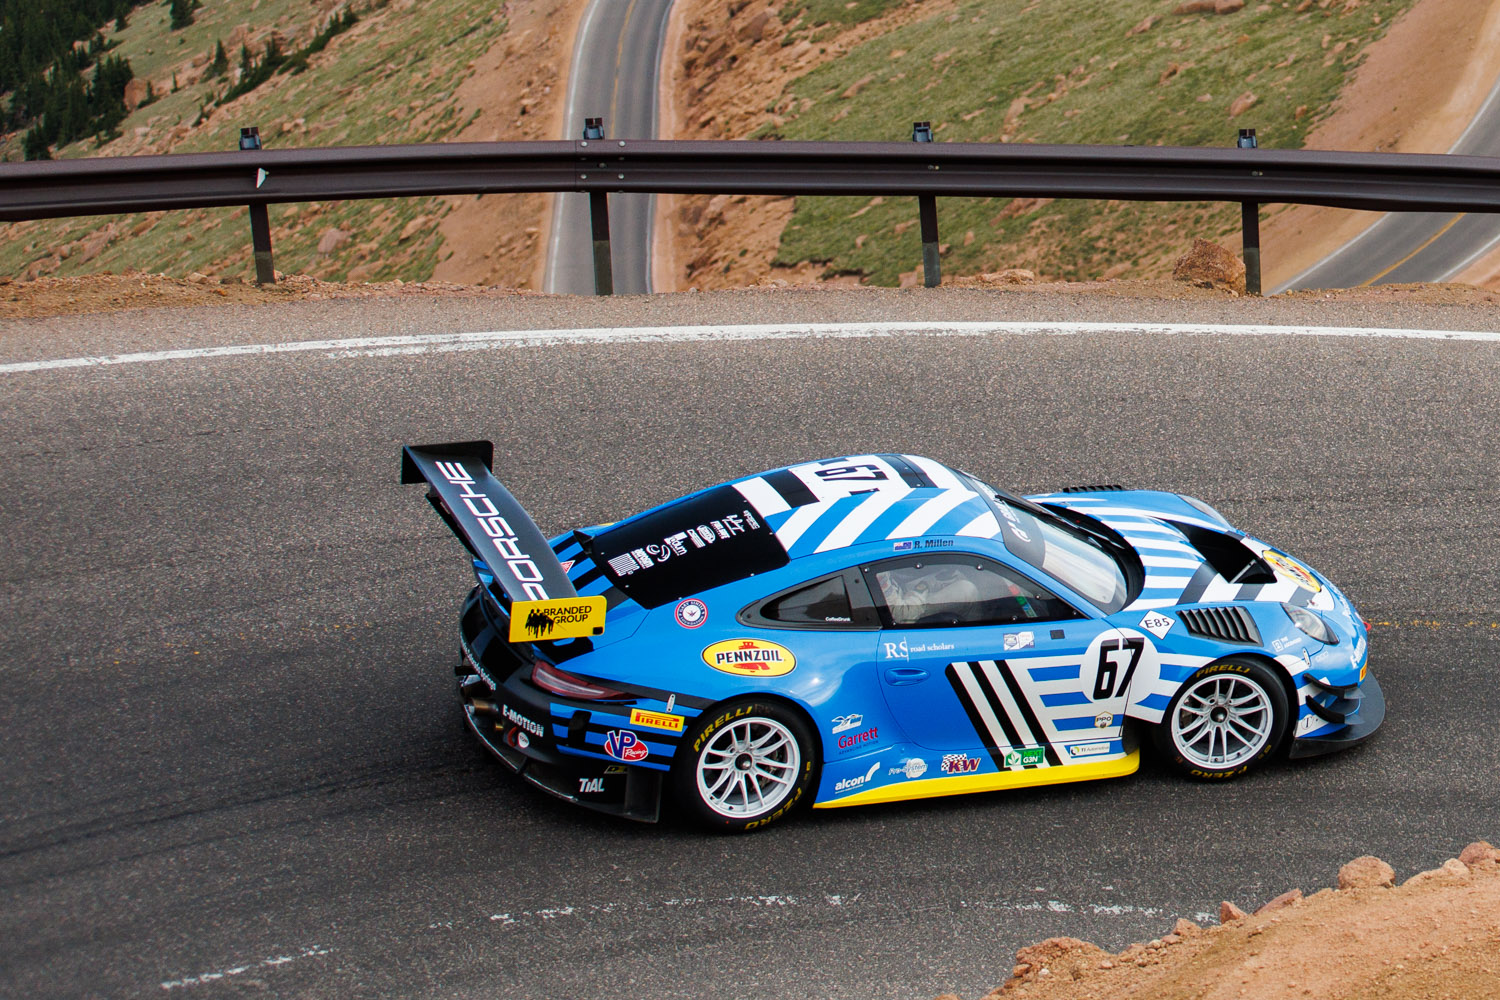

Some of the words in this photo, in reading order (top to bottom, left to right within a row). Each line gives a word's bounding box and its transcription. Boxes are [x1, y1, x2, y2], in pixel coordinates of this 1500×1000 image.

[814, 464, 889, 482] 67
[914, 539, 923, 549] R.
[924, 538, 954, 548] Millen
[542, 605, 592, 617] BRANDED
[552, 614, 589, 625] GROUP
[1144, 617, 1170, 629] E85
[716, 649, 783, 664] PENNZOIL
[885, 638, 909, 660] RS
[910, 643, 926, 653] road
[926, 642, 955, 652] scholars
[1093, 637, 1145, 701] 67
[1195, 664, 1251, 678] PIRELLI
[502, 704, 544, 737] E-MOTION
[635, 712, 680, 729] PIRELLI
[693, 705, 753, 752] PIRELLI
[607, 730, 637, 760] VP
[625, 748, 648, 757] Racing
[838, 727, 879, 750] Garrett
[1023, 749, 1043, 757] NEXT
[948, 757, 981, 774] KW
[834, 774, 865, 791] alcon
